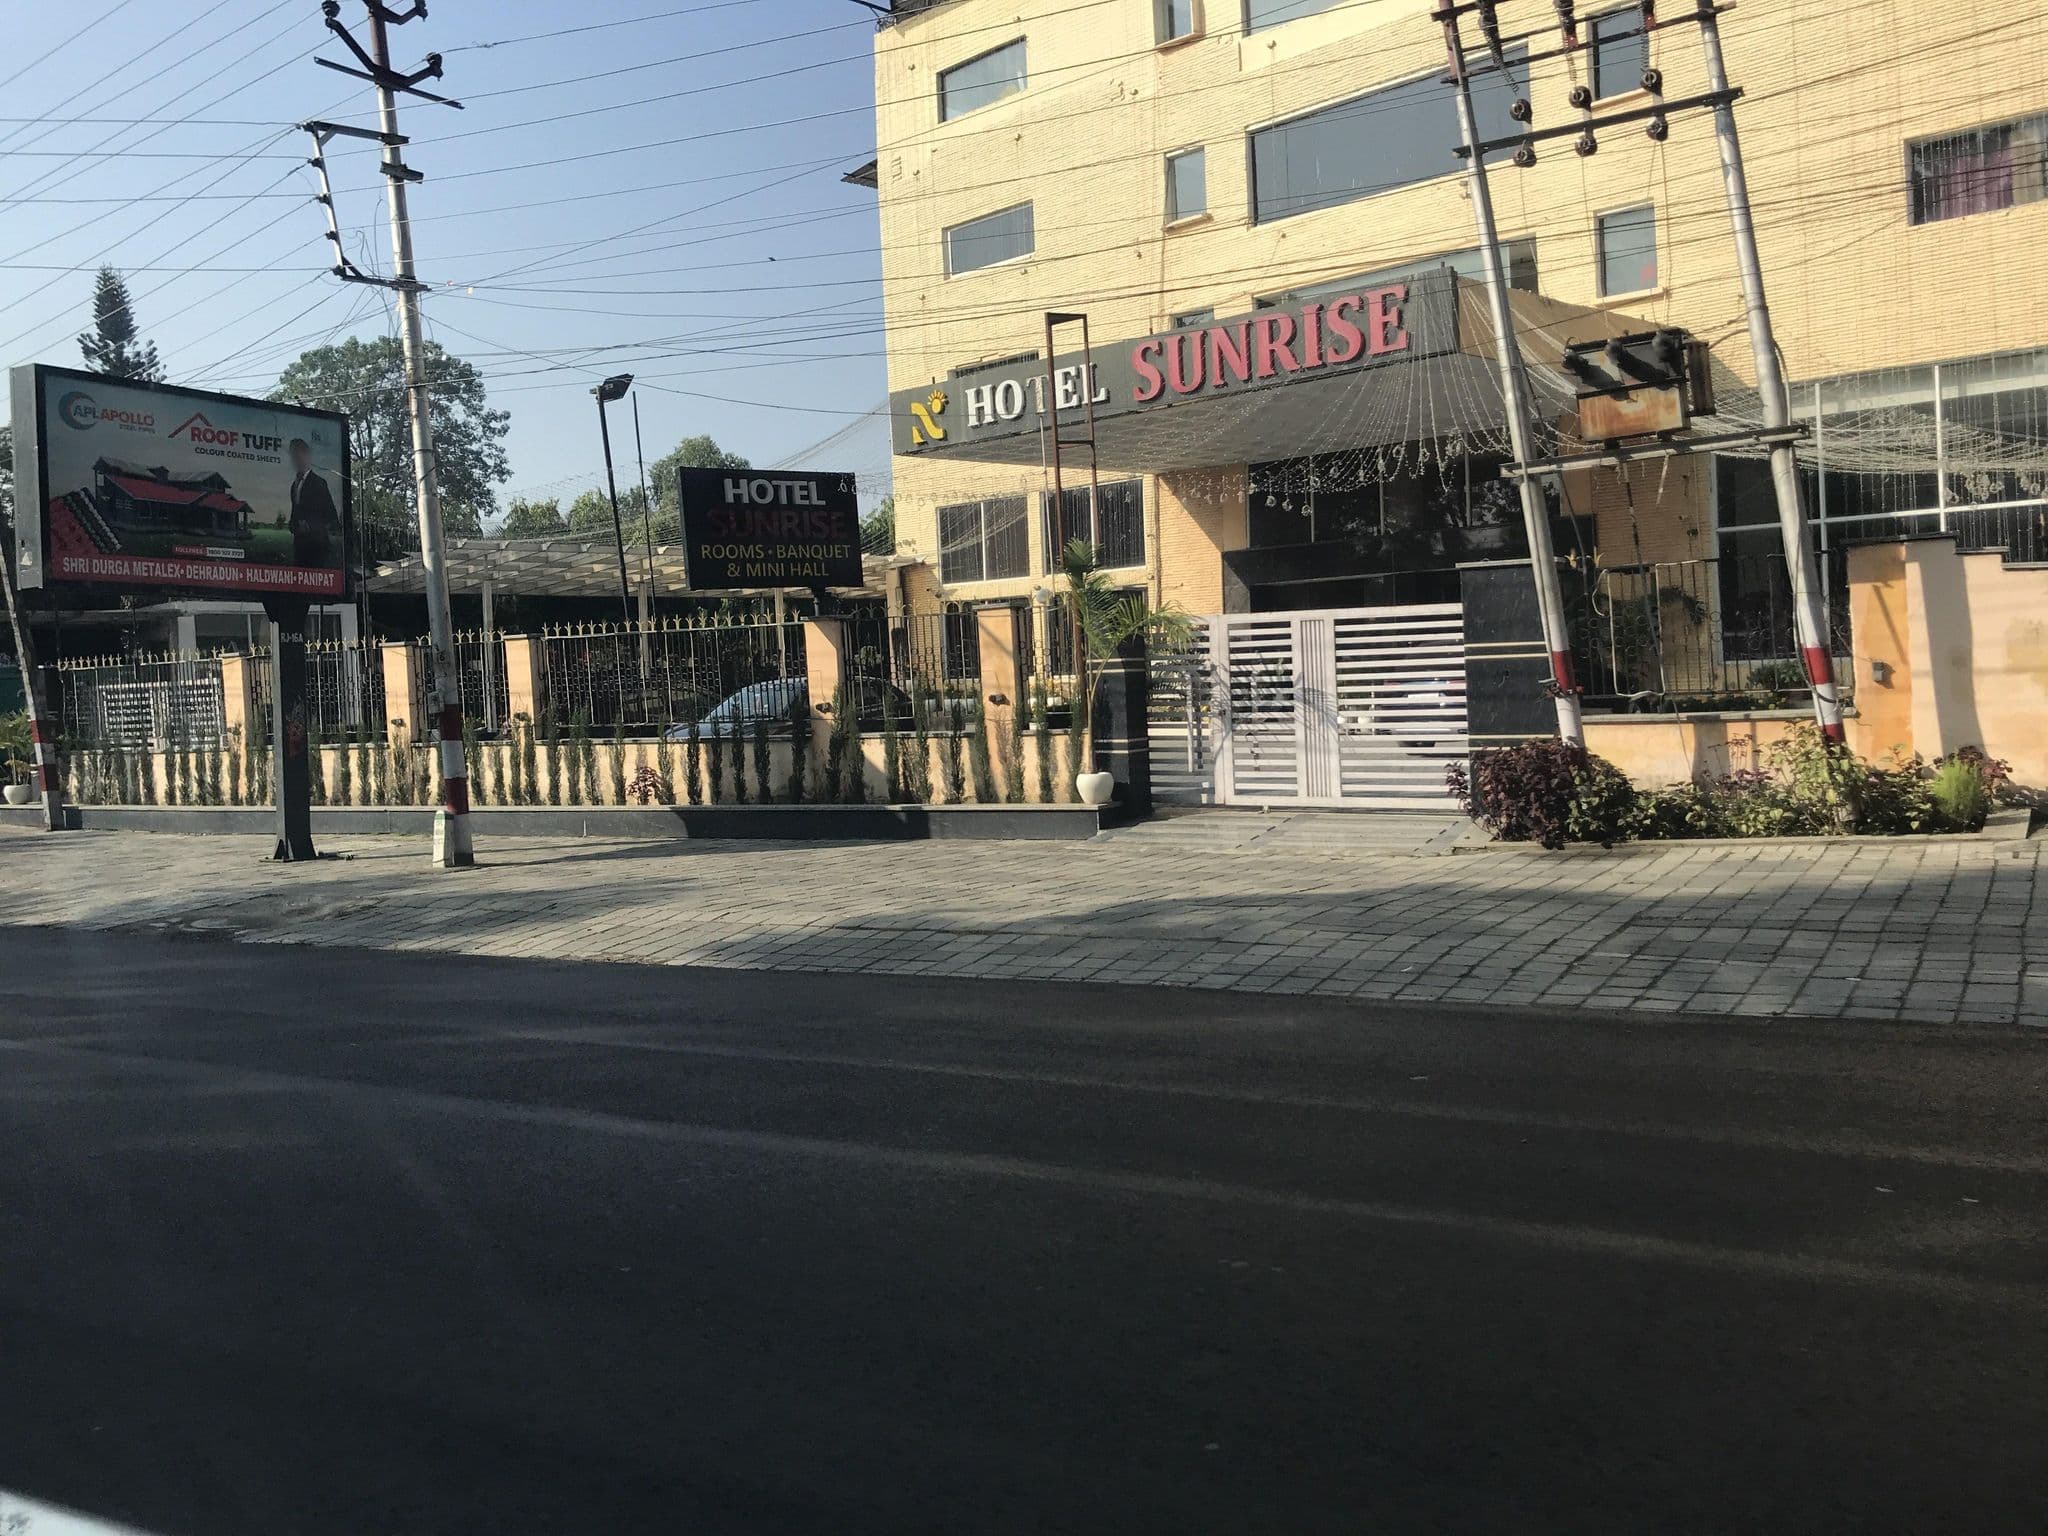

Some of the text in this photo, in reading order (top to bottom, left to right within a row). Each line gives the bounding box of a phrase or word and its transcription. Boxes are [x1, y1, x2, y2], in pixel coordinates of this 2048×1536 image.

[965, 283, 1409, 427] HOTEL SUNRISE
[191, 426, 282, 452] ROOF TUFF
[195, 446, 281, 464] COLOUR COATED SHEETS
[723, 478, 826, 506] HOTEL
[706, 508, 848, 538] SUNRISE
[701, 544, 851, 560] ROOMS BANQUET
[63, 557, 334, 587] SHRI DURGA METALEX DEHRADUN HALDWANI PANIPAT
[727, 562, 829, 577] & MINI HALL
